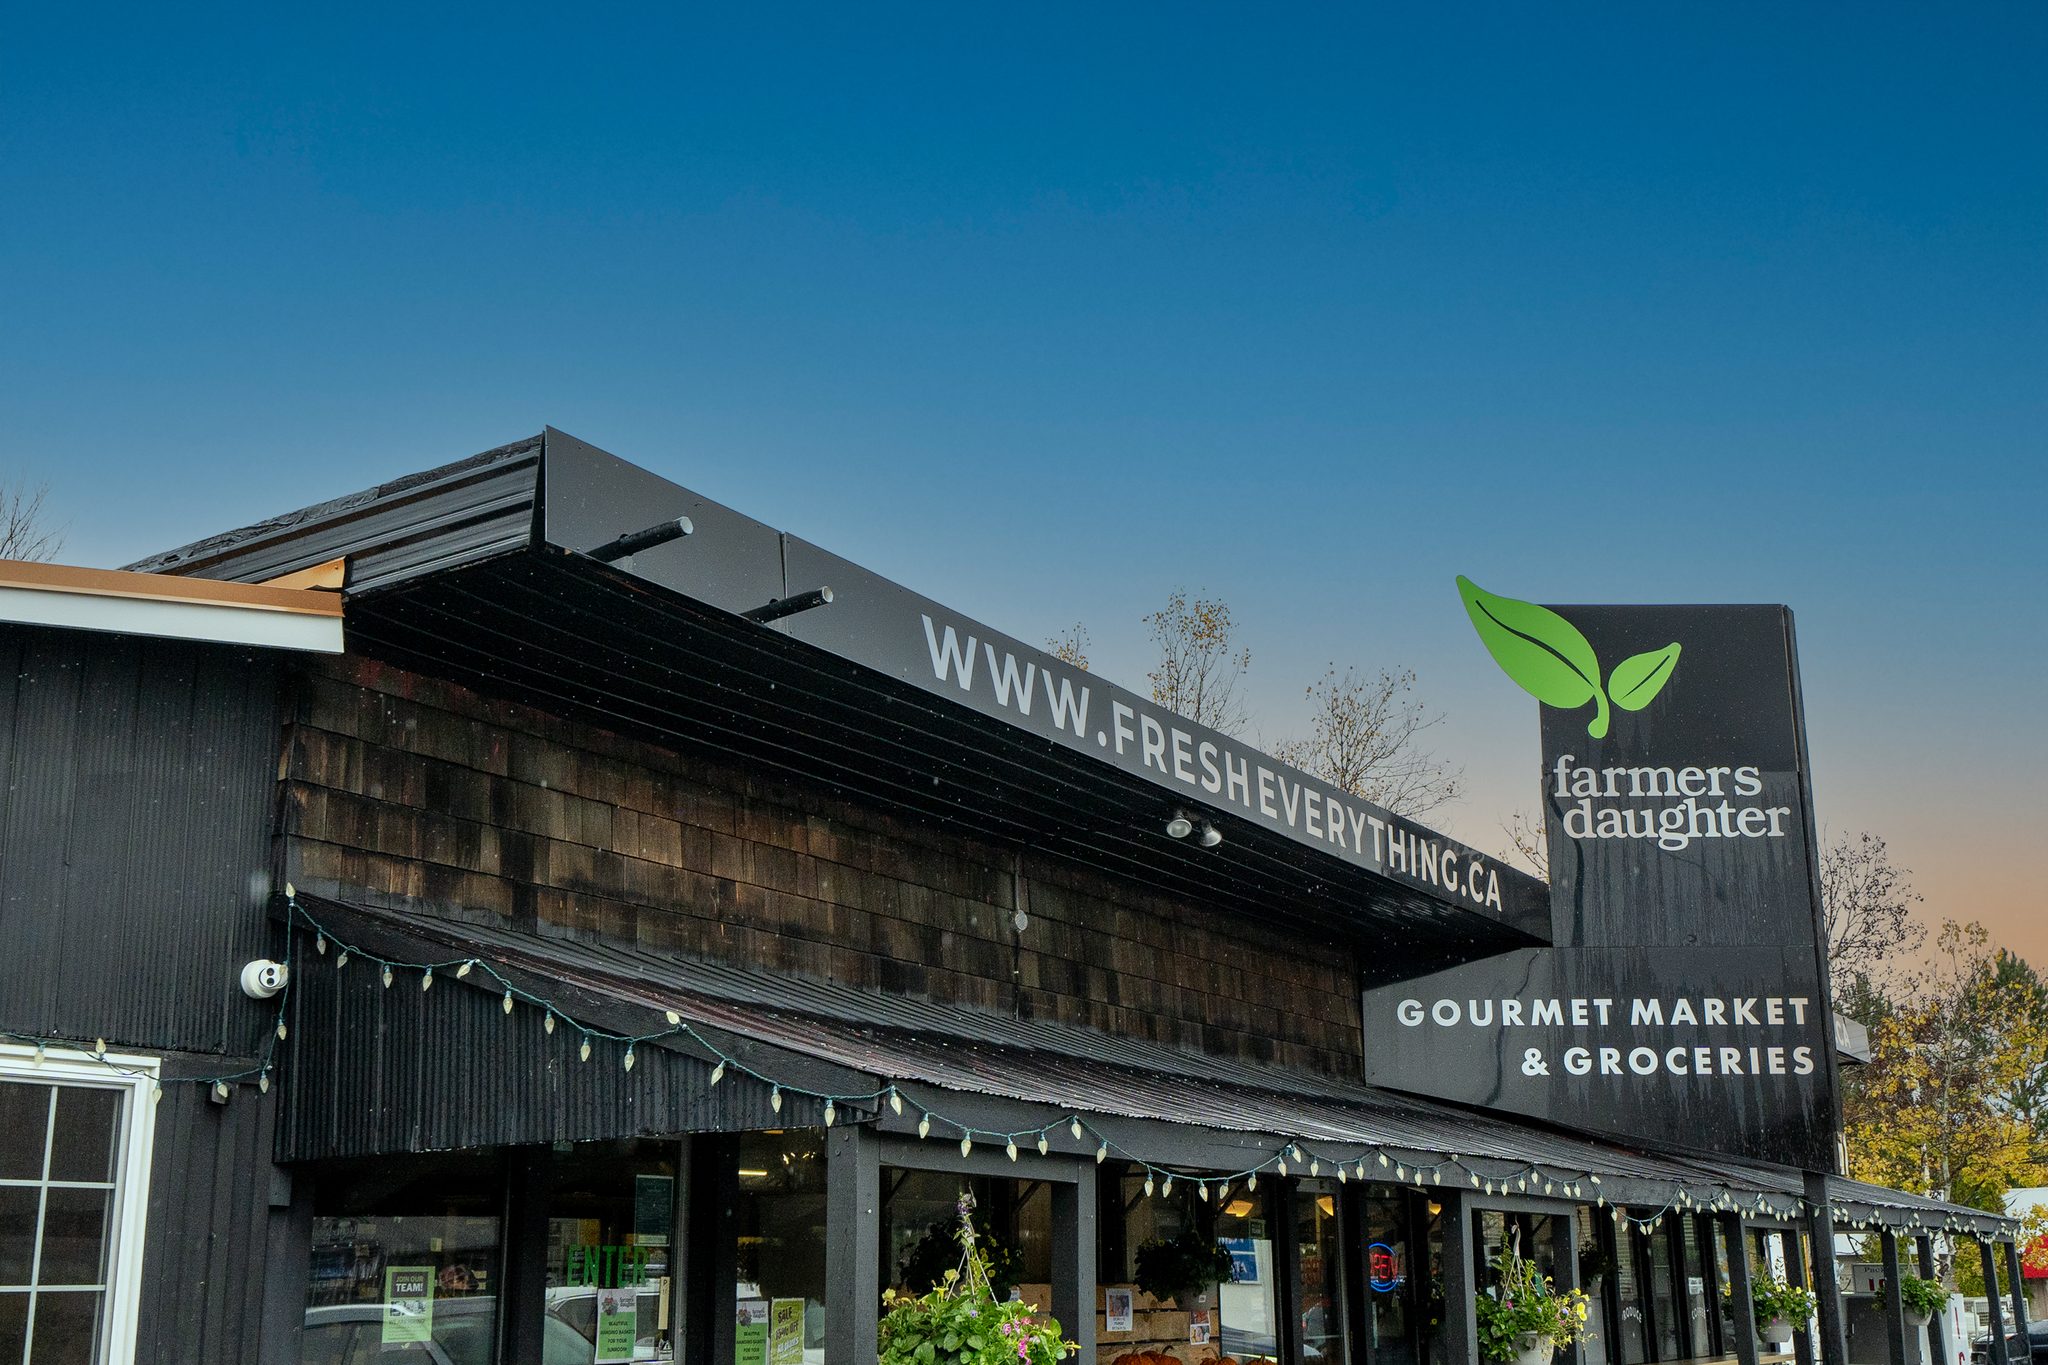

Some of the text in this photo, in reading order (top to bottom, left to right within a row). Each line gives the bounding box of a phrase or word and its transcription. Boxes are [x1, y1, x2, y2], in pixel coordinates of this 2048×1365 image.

[921, 613, 1502, 912] WWW.FRESHEVERYTHING.CA
[1553, 755, 1763, 798] farmers
[1563, 797, 1790, 851] daughter
[1397, 997, 1809, 1027] GOURMET MARKET
[1521, 1046, 1815, 1077] & GROCERIES
[396, 1283, 424, 1292] TEAM!
[567, 1244, 650, 1288] ENTER
